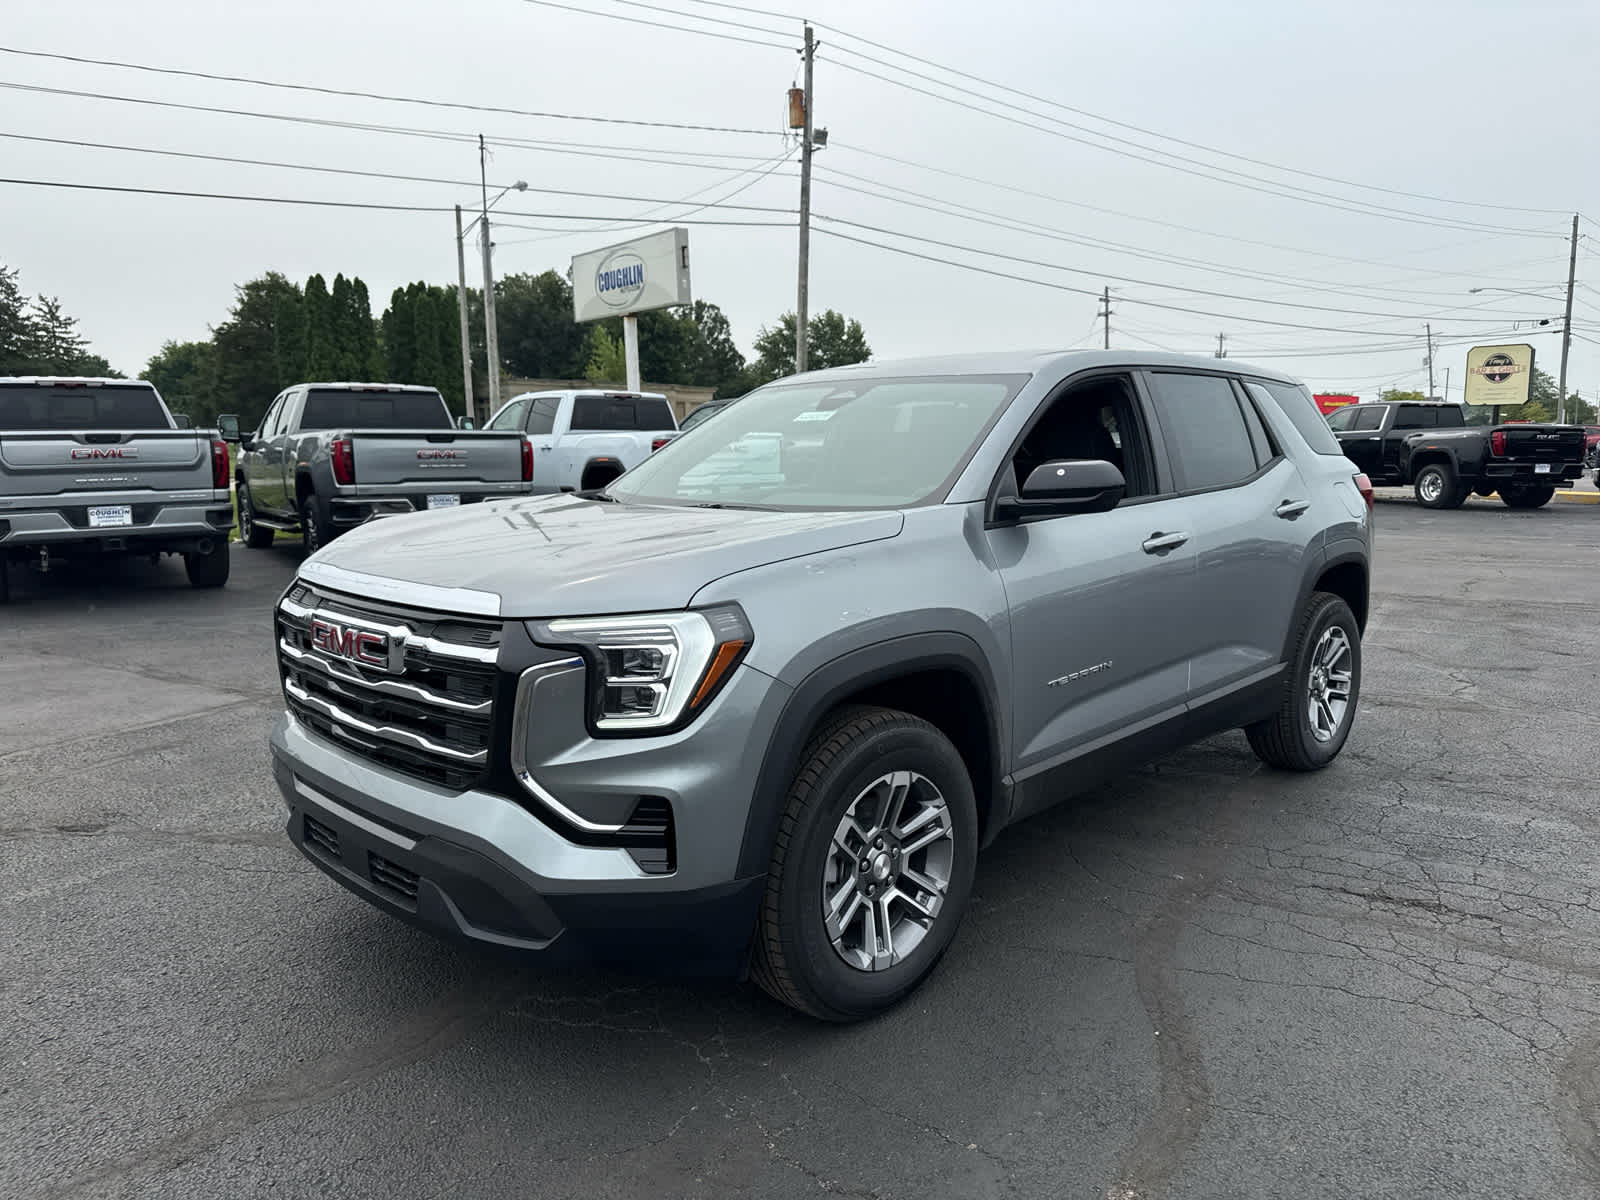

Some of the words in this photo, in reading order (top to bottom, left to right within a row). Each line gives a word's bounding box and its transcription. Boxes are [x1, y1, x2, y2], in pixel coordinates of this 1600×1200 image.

[598, 263, 644, 293] COUGHLIN
[71, 448, 138, 460] GMC
[416, 449, 468, 460] GMC
[90, 508, 130, 517] COUGHLIN
[310, 619, 388, 667] GMC
[1047, 659, 1113, 687] TERRAIN
